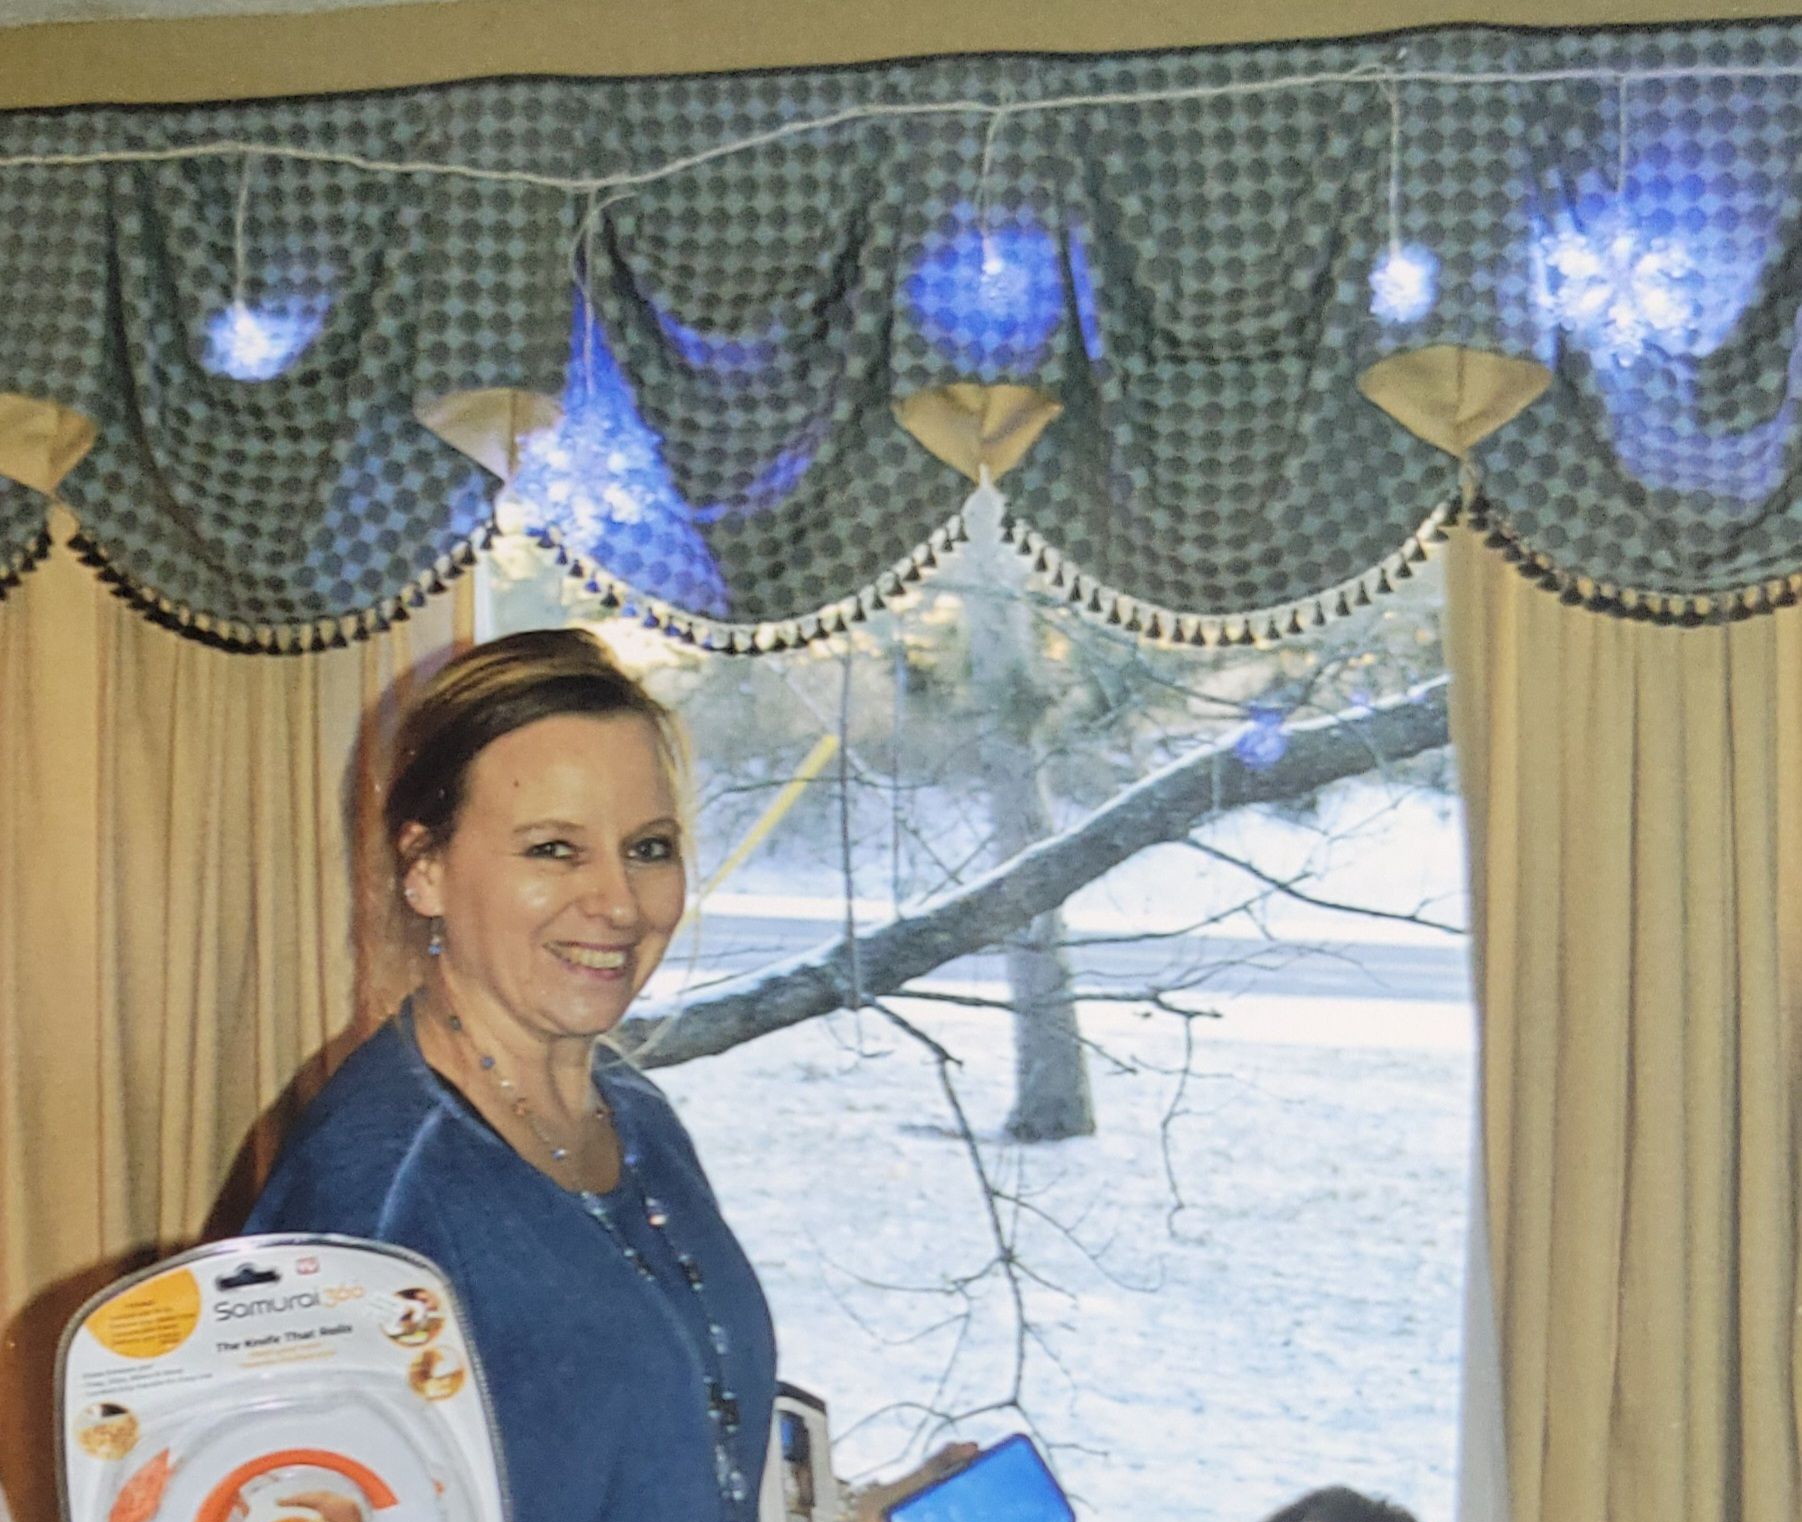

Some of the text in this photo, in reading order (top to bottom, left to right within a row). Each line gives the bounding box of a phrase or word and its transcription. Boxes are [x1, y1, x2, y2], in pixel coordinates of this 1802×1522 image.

[216, 1341, 241, 1352] The
[244, 1335, 281, 1349] Knife
[284, 1329, 315, 1342] That
